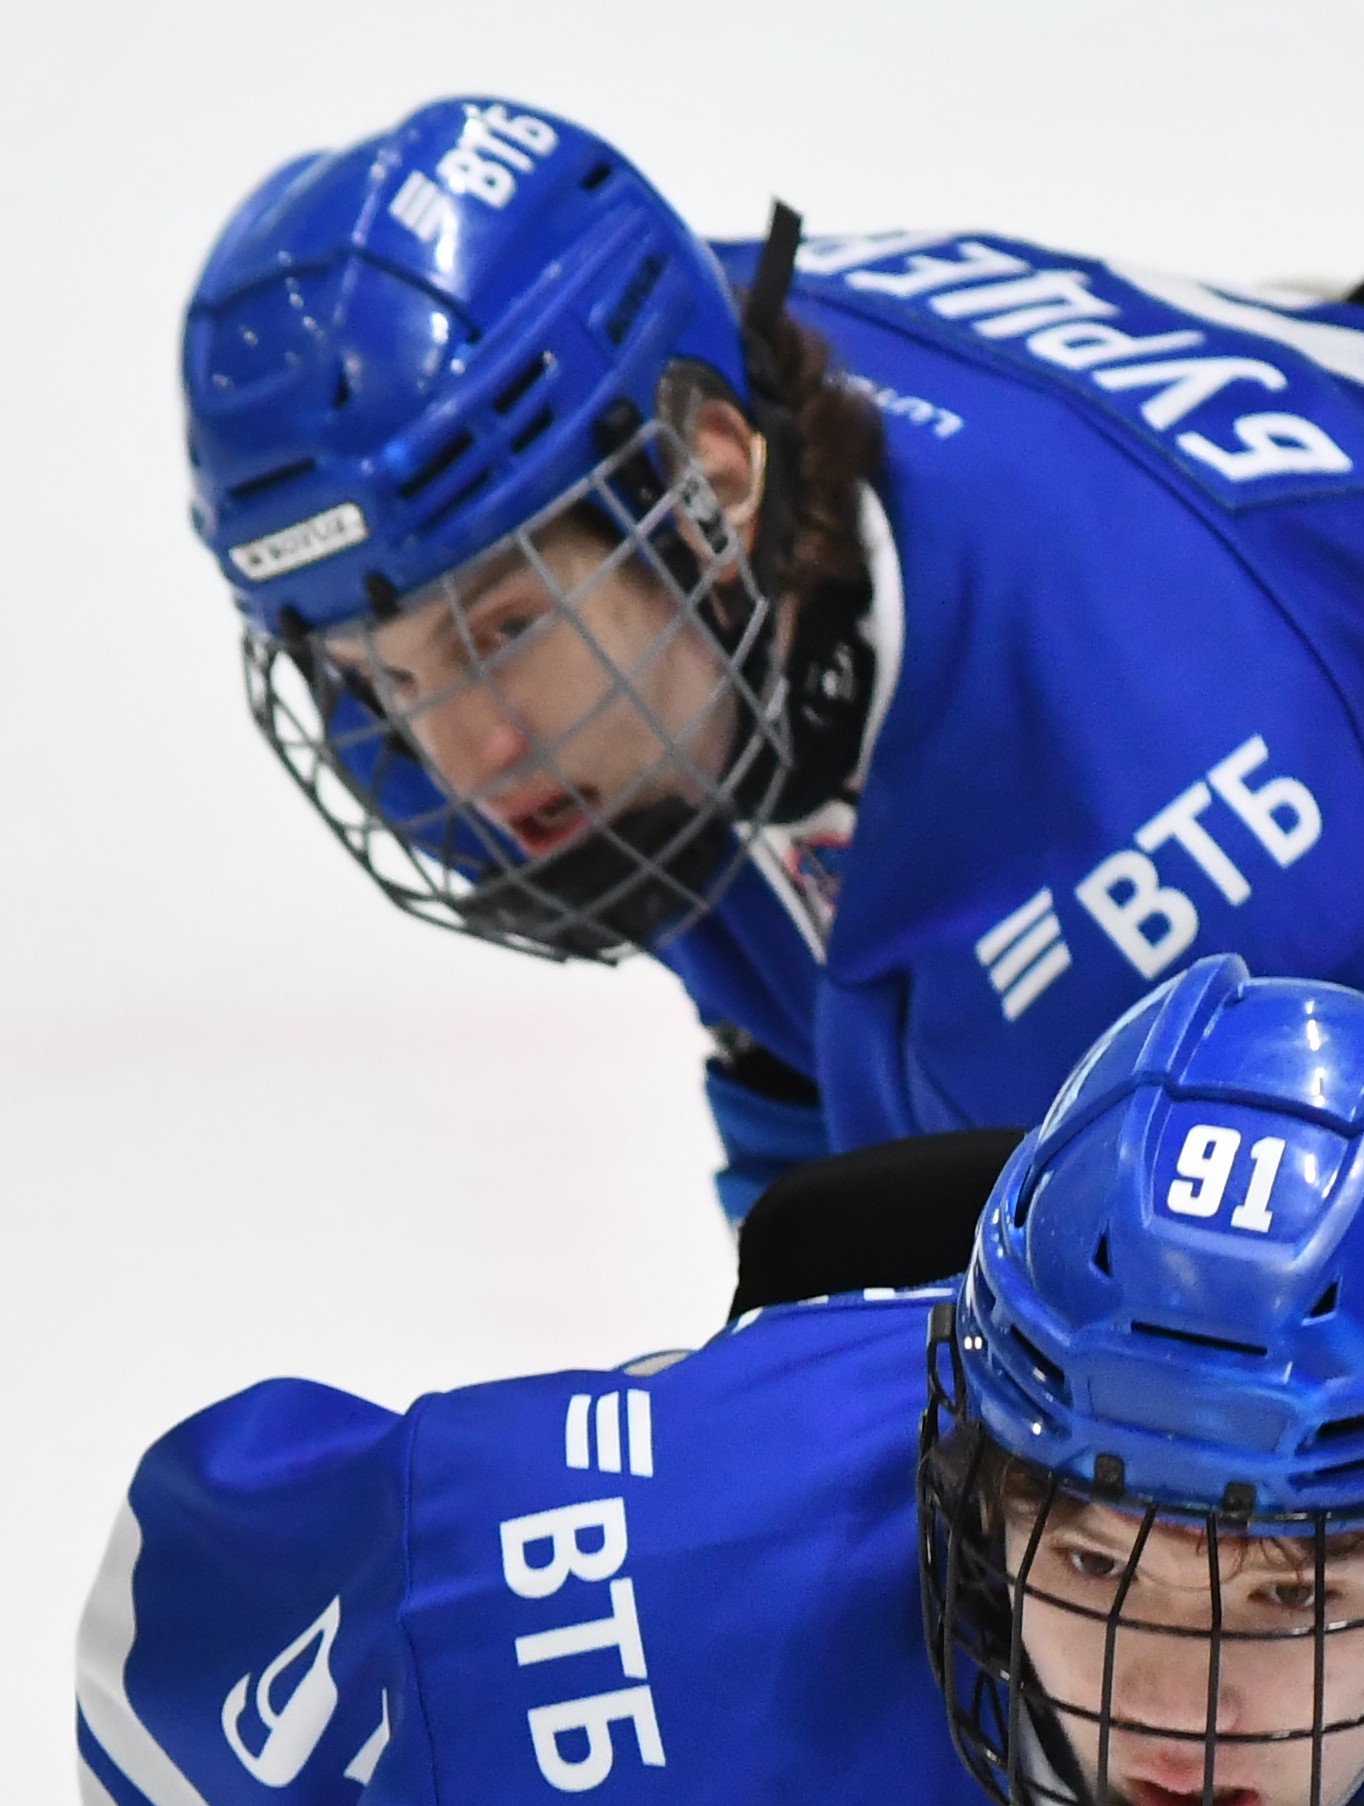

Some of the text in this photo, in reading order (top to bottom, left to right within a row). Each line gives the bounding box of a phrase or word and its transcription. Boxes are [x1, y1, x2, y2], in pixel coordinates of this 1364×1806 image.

[436, 103, 560, 211] ВТБ
[1074, 733, 1324, 981] ВТБ
[1165, 1123, 1287, 1234] 91
[499, 1497, 667, 1793] ВТБ
